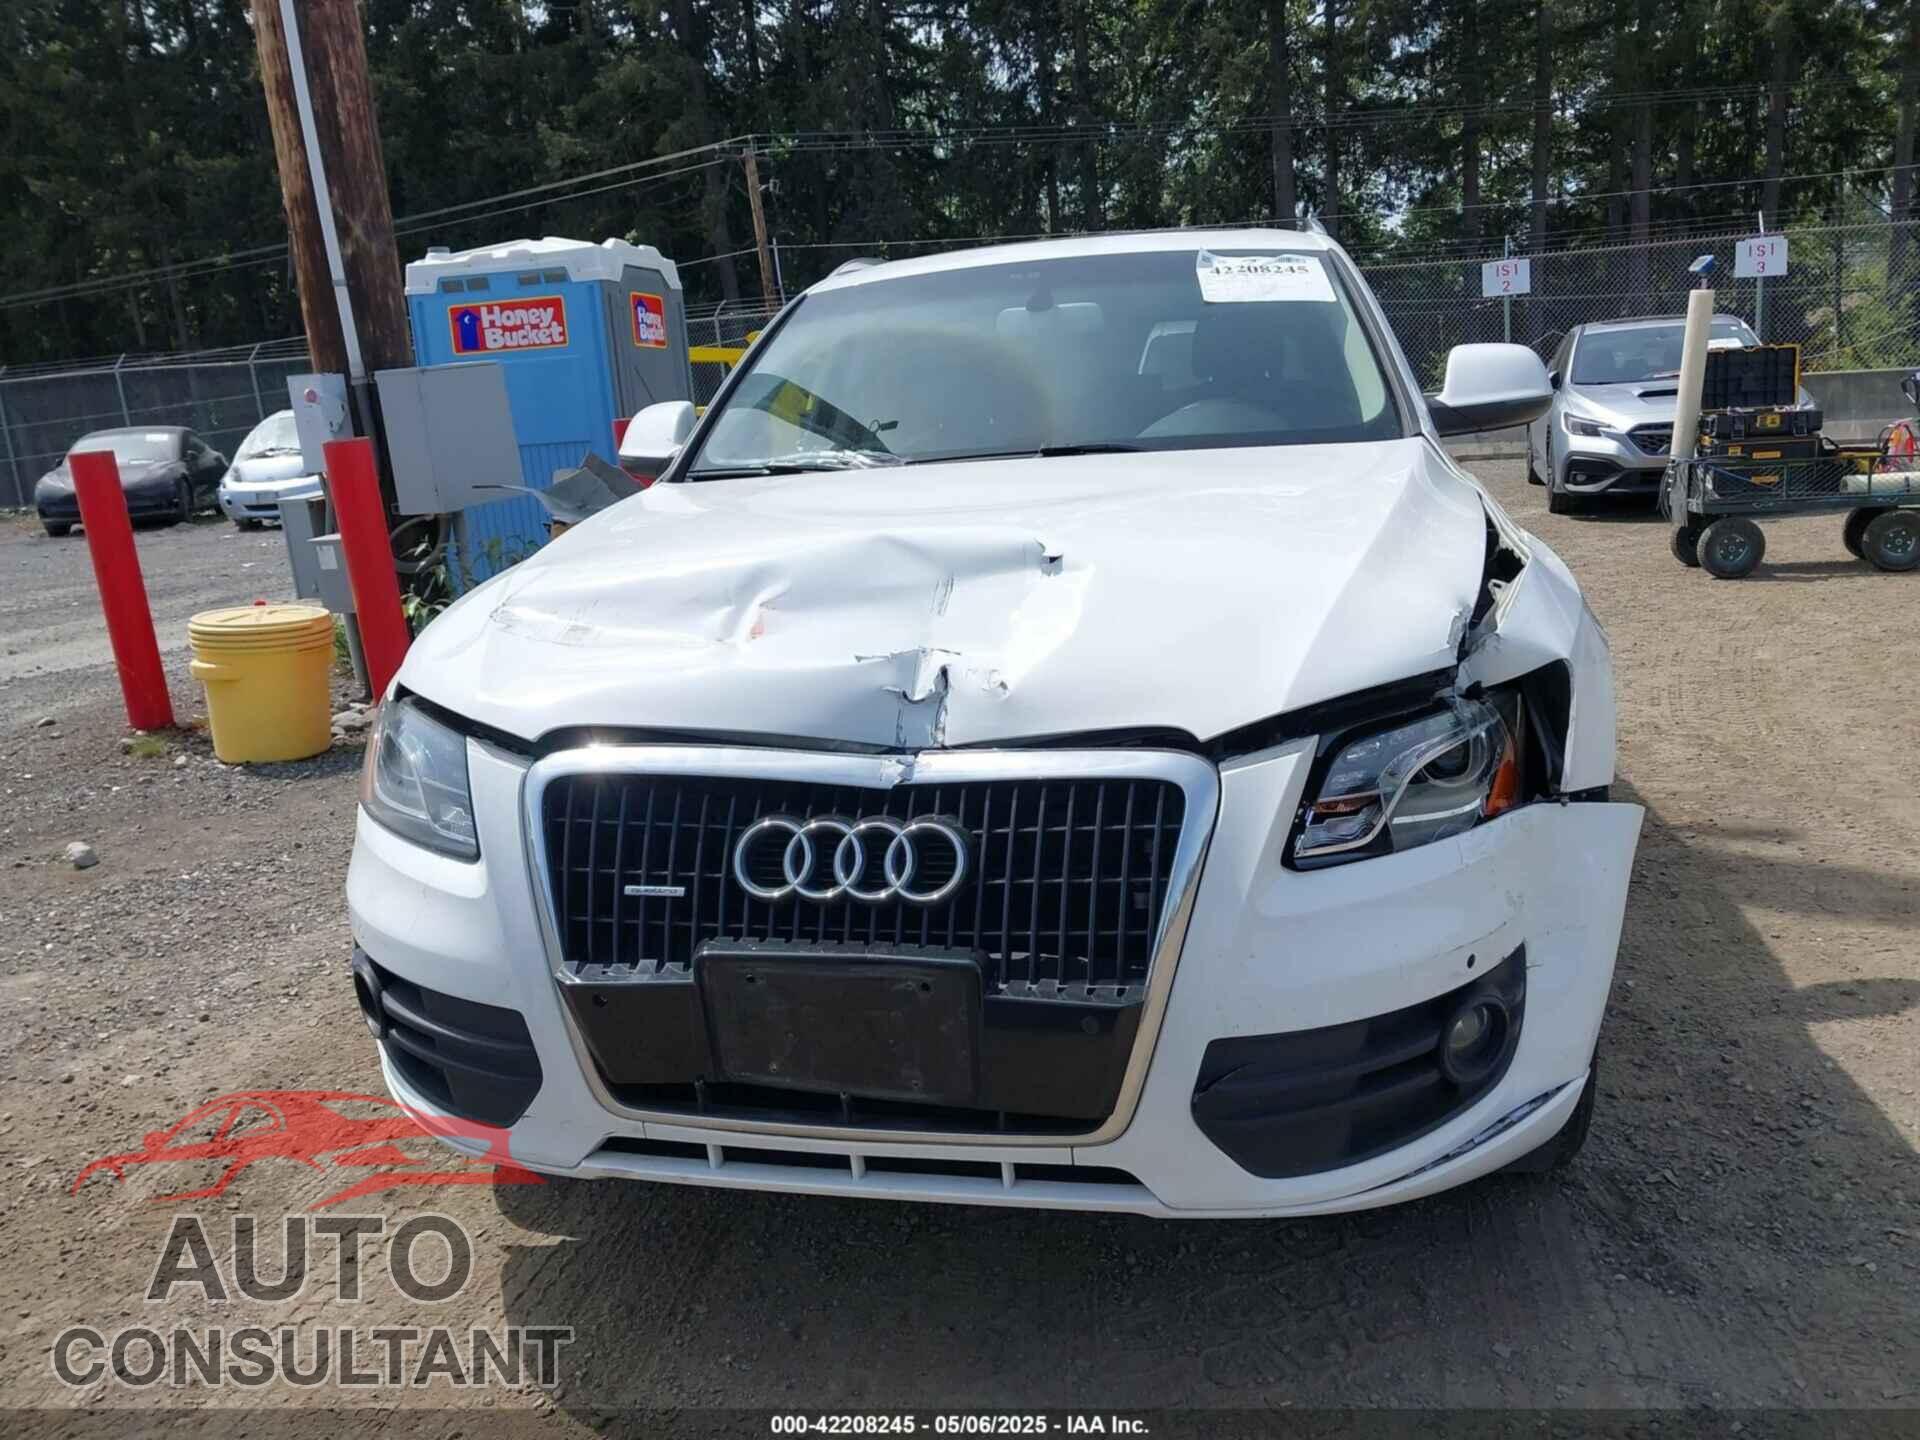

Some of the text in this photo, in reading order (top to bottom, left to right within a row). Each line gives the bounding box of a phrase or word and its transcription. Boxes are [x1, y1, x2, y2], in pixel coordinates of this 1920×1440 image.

[1757, 261, 1766, 273] 3
[1503, 280, 1511, 292] 2
[481, 305, 554, 328] Honey
[485, 323, 565, 349] Bucket
